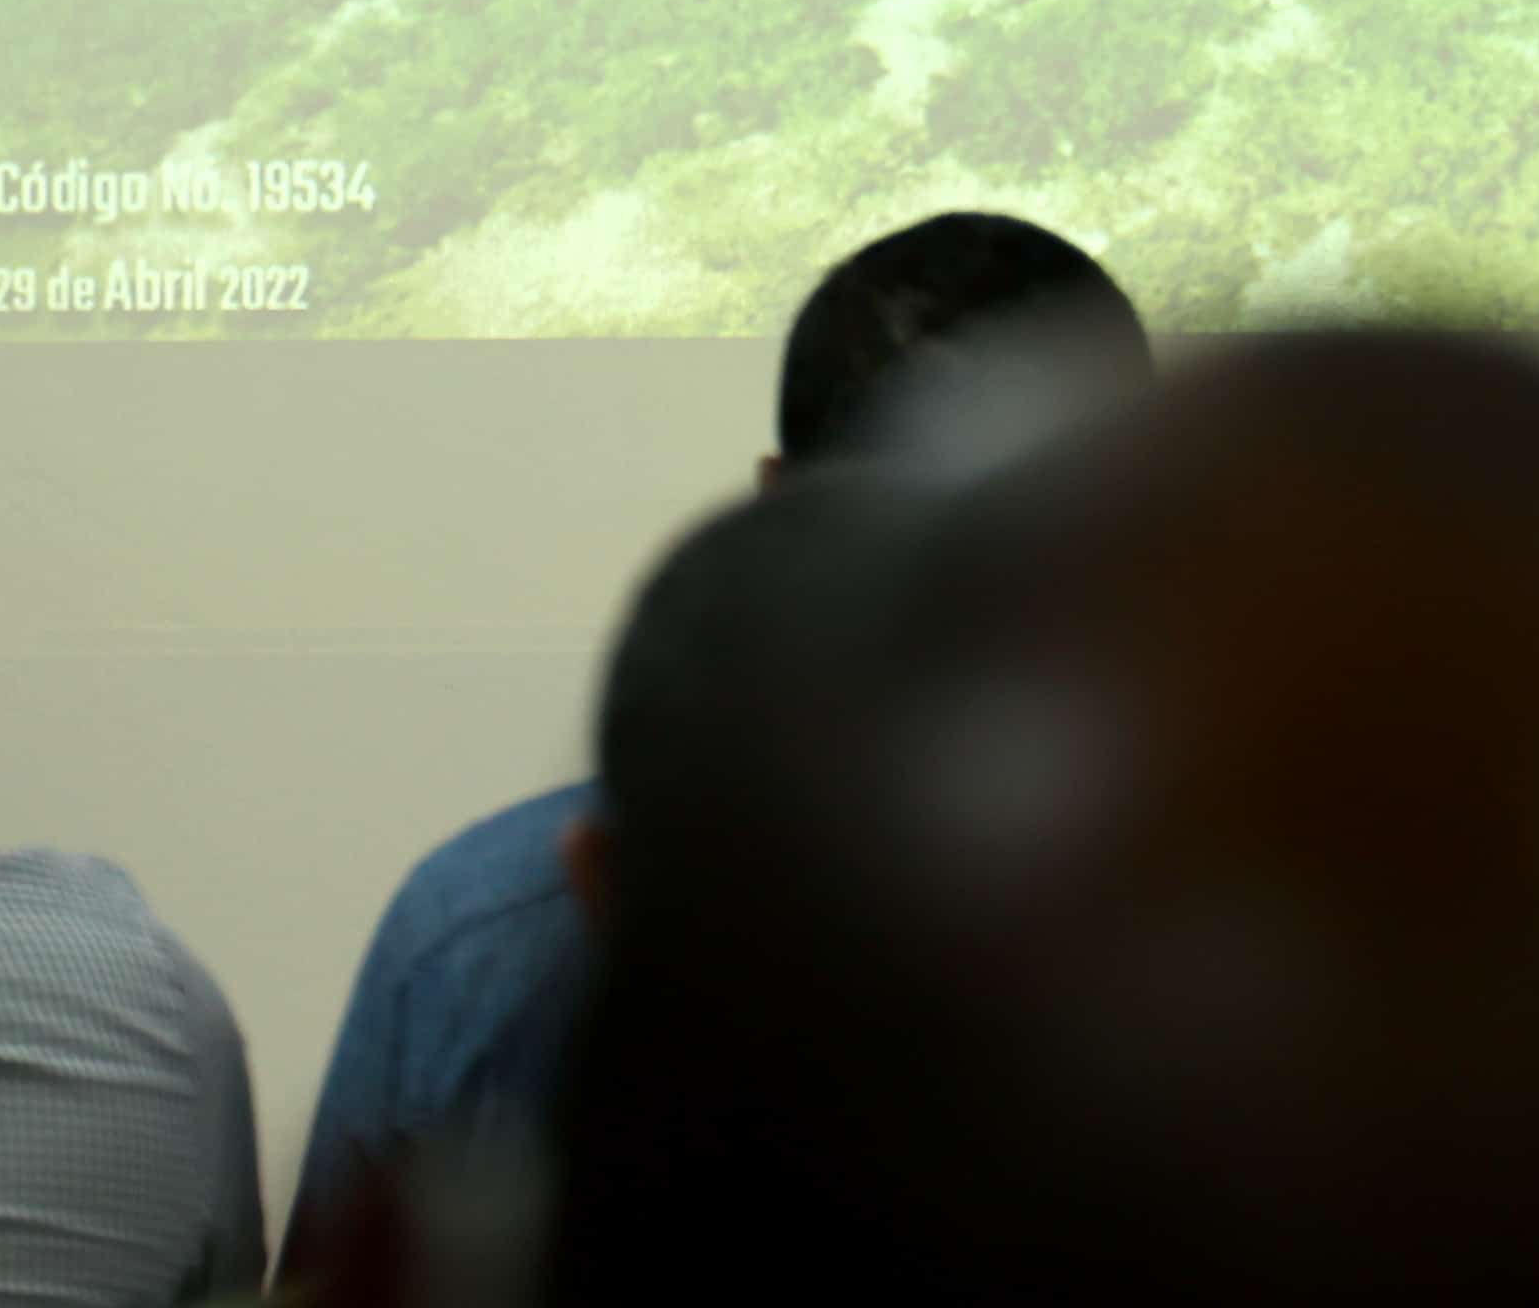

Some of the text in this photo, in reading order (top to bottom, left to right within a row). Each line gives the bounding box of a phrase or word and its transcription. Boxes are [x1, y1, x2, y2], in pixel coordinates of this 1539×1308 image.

[246, 159, 378, 212] 19534
[47, 265, 95, 312] de
[104, 259, 206, 312] Abril
[219, 264, 310, 312] 2022
